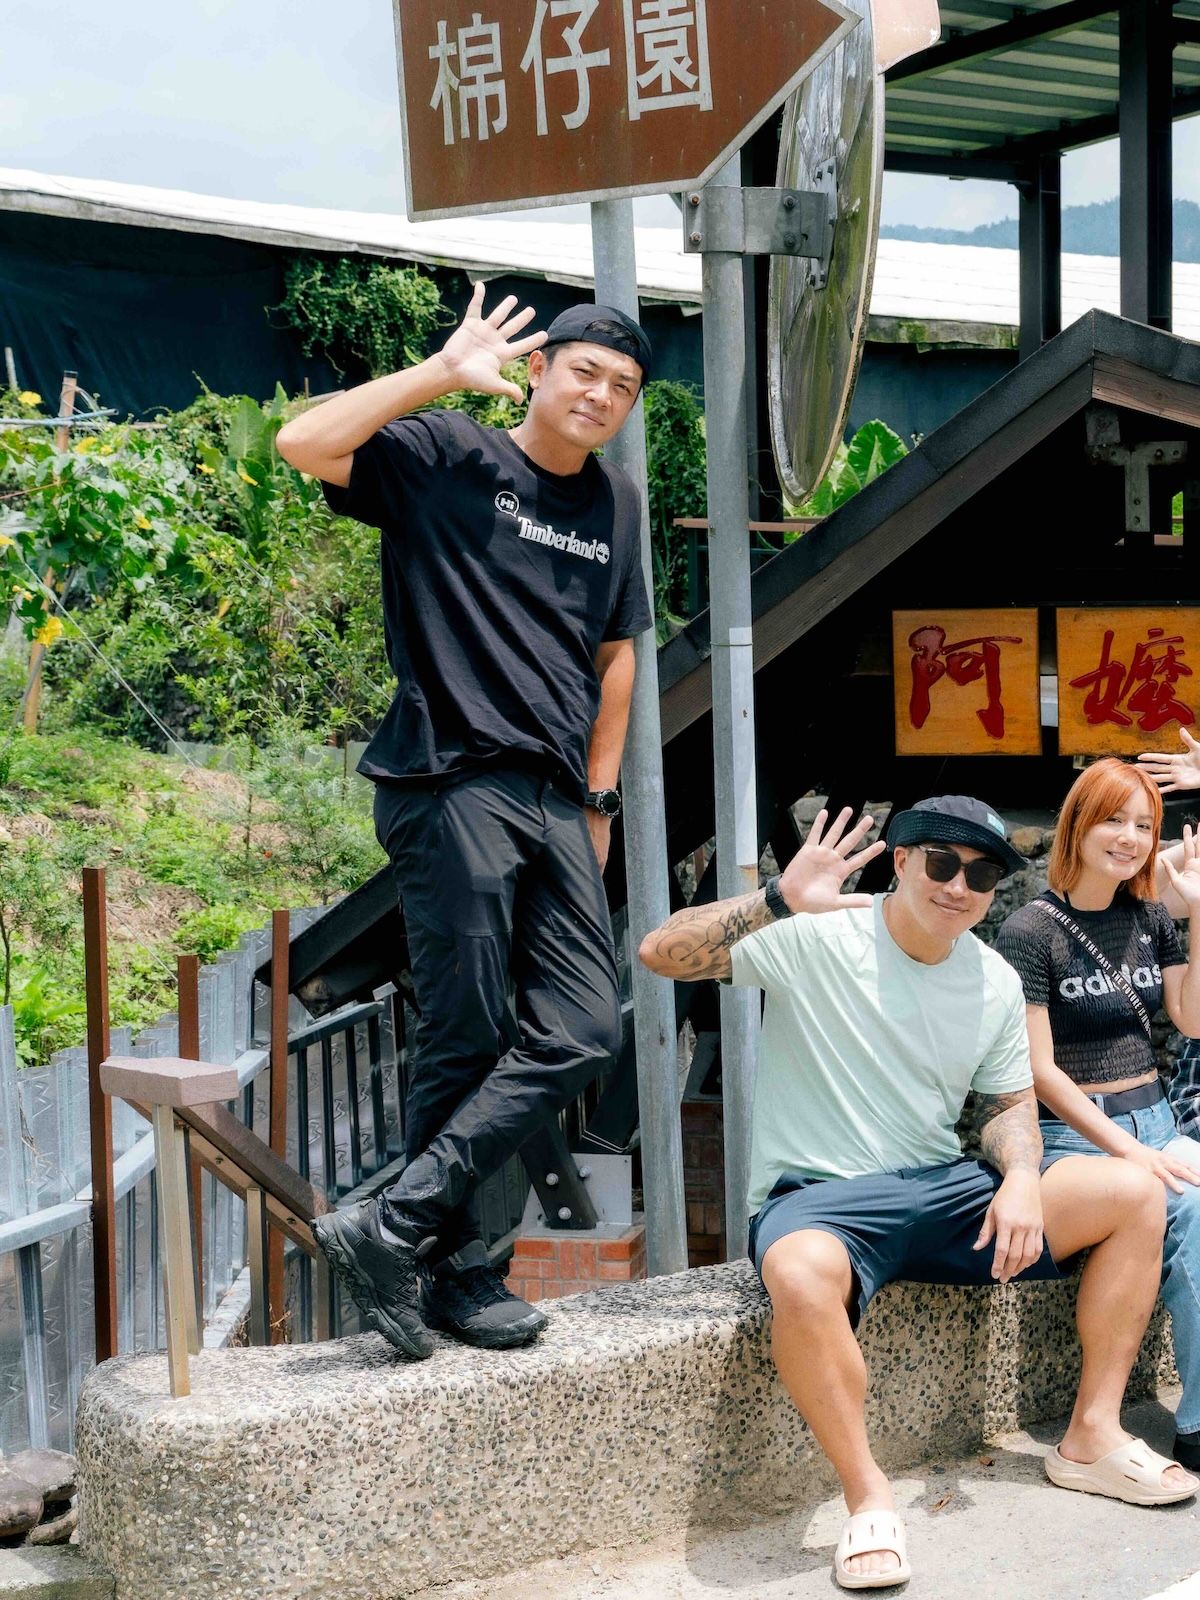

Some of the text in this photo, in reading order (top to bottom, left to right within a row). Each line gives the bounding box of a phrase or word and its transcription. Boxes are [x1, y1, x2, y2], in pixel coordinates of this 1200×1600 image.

[428, 0, 713, 146] 棉仔園
[499, 497, 514, 510] Hi
[518, 516, 597, 561] Timberland
[1044, 905, 1071, 925] FUTURE
[1069, 924, 1079, 933] IS
[1078, 932, 1087, 942] IN
[1085, 940, 1098, 955] THE
[1096, 953, 1112, 971] PAST
[1111, 970, 1124, 985] THE
[1121, 983, 1142, 1009] FUTURE
